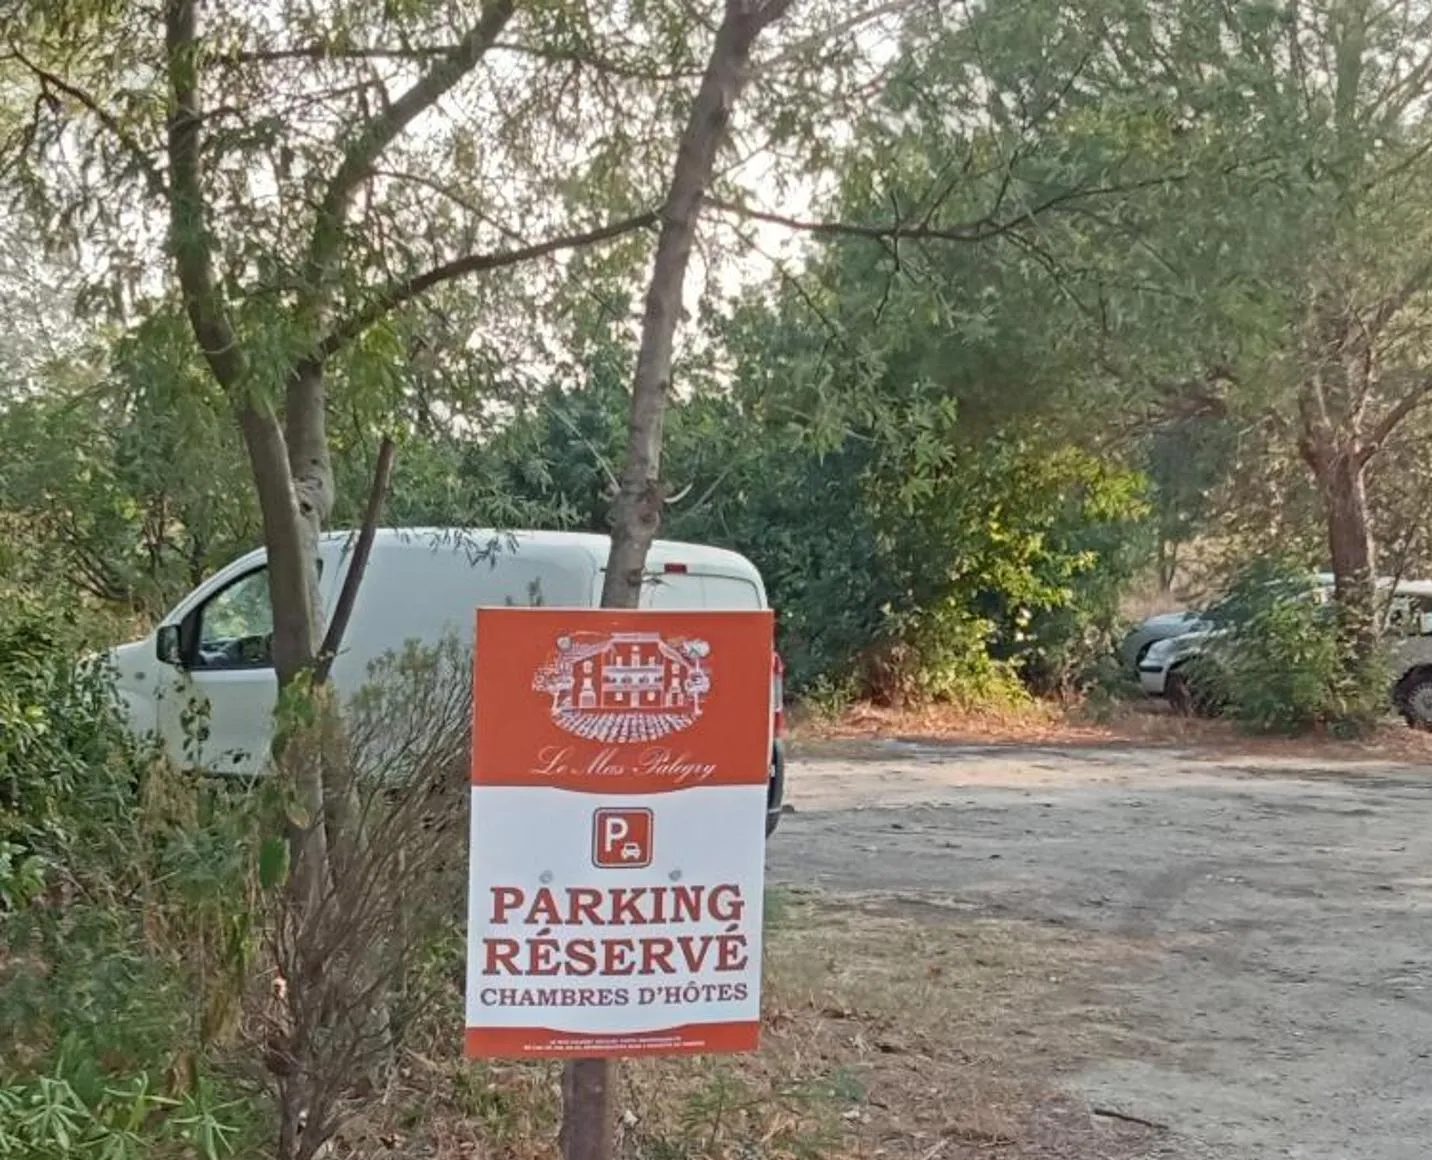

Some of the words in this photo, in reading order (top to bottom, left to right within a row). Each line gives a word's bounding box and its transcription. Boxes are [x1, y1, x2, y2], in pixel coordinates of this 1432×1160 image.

[529, 745, 567, 776] Le
[604, 817, 629, 852] P
[489, 884, 746, 926] PARKING
[481, 923, 749, 977] RÉSERVÉ
[480, 988, 630, 1008] CHAMBRES
[638, 981, 748, 1006] D'HÔTES
